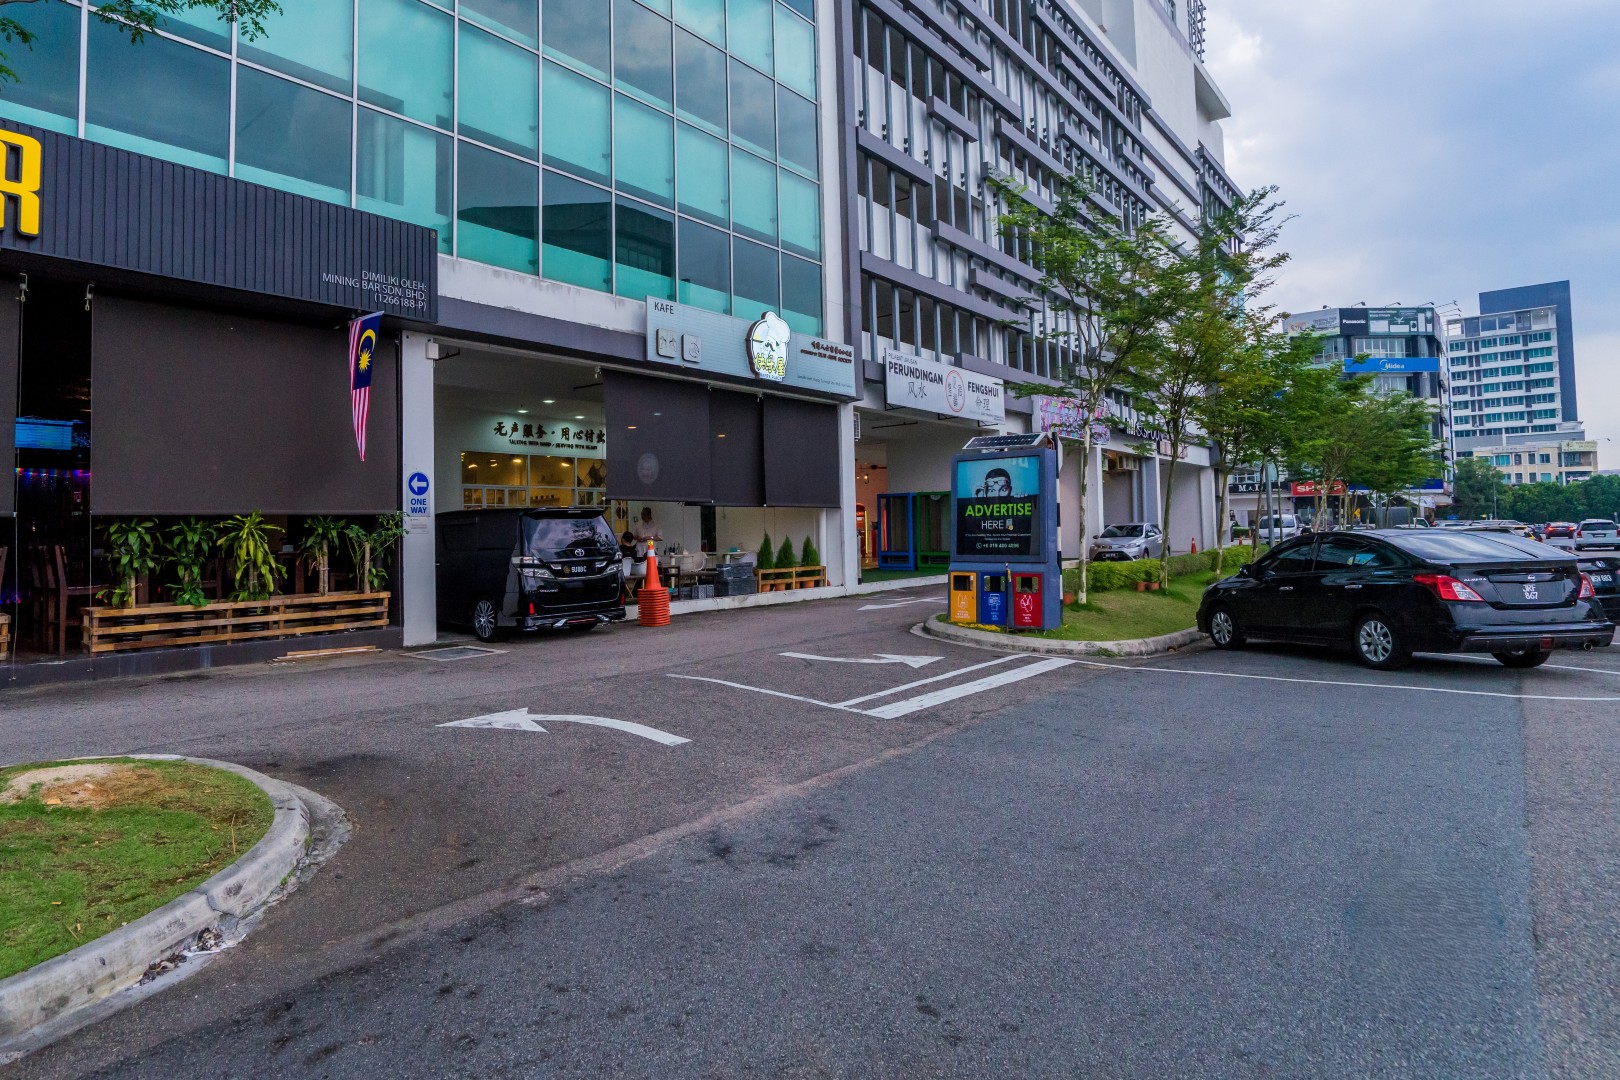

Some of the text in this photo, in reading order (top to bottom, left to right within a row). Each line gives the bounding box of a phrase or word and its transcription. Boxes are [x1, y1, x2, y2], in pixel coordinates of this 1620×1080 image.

[322, 272, 427, 301] MINING BAR SDN. BHD.
[362, 270, 427, 292] DIMILIKI OLEH:
[374, 292, 427, 312] (1266188-P)
[654, 301, 675, 315] KAFE
[1383, 361, 1405, 369] Midea
[888, 360, 944, 386] PERUNDINGAN
[967, 380, 999, 398] FENGSHUI
[410, 498, 427, 506] ONE
[410, 506, 428, 514] WAY
[965, 503, 1032, 517] ADVERTISE
[981, 520, 1005, 530] HERE
